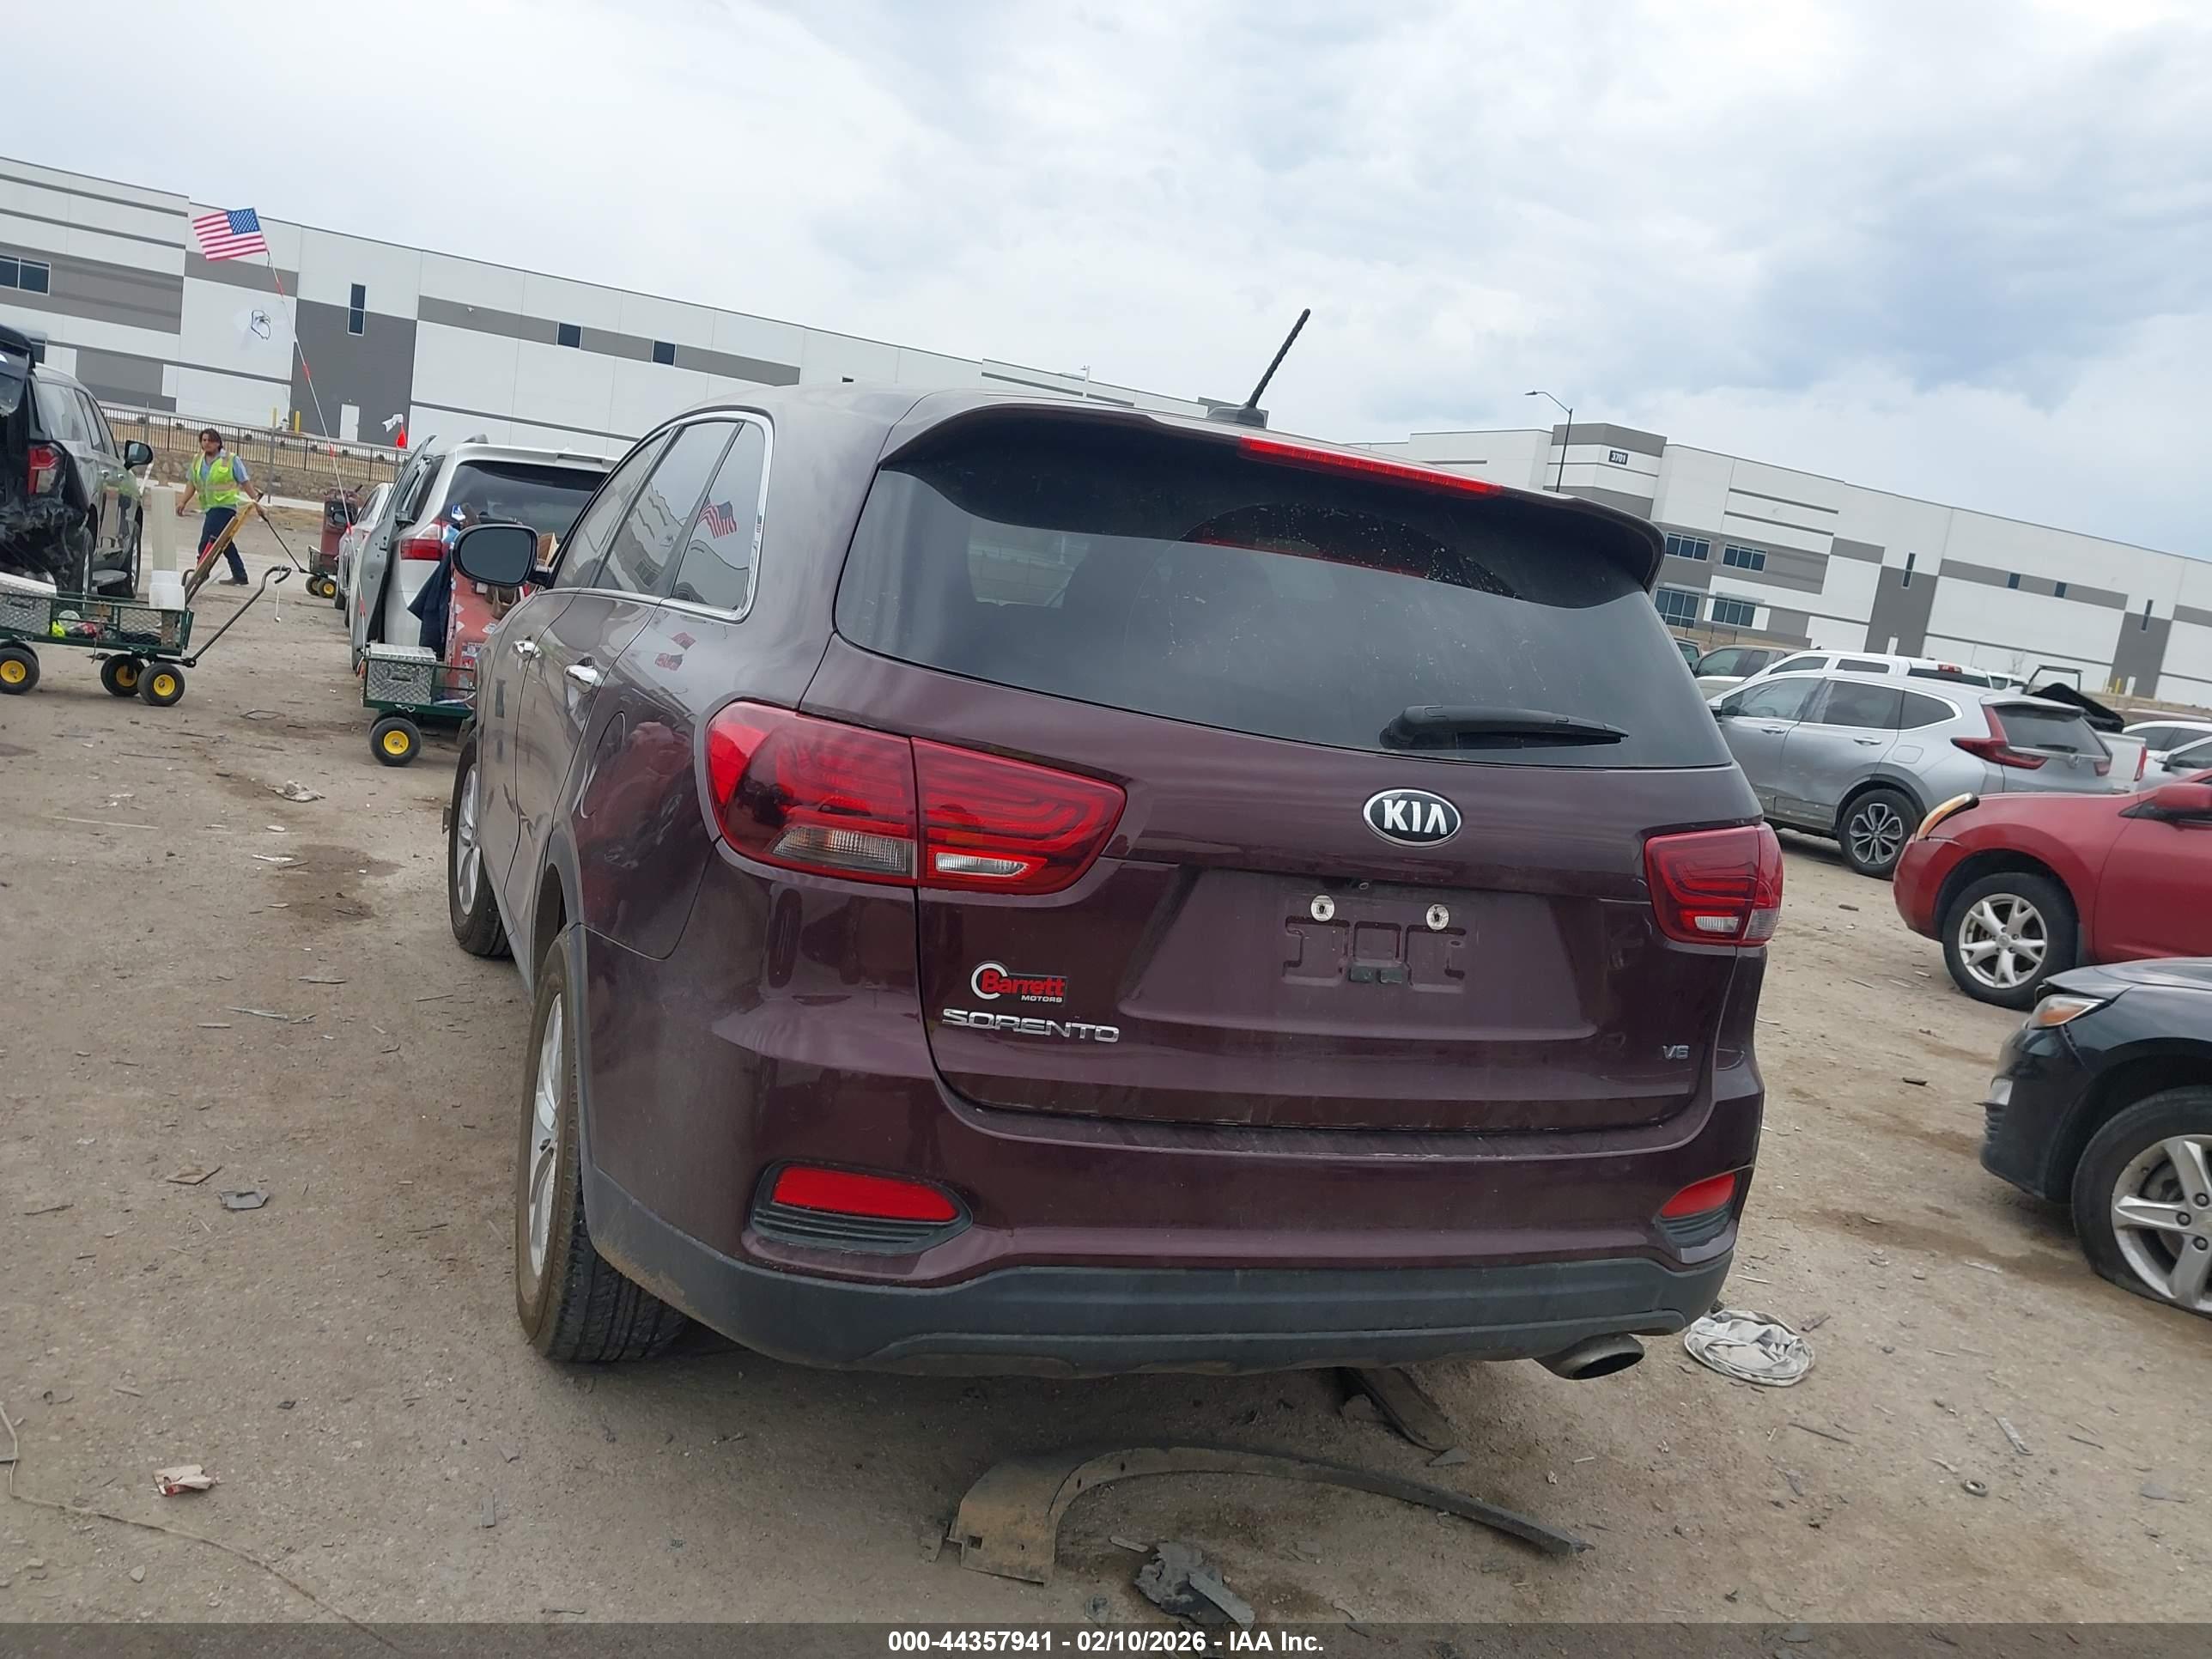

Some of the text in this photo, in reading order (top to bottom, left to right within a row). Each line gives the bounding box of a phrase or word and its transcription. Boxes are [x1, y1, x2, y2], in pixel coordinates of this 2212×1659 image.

[1611, 453, 1626, 464] 3701
[1382, 799, 1448, 835] KIA
[981, 970, 1066, 996] Barrett
[1020, 994, 1063, 1003] MOTORS
[942, 1008, 1121, 1043] SORENTO
[1662, 1045, 1689, 1059] V6
